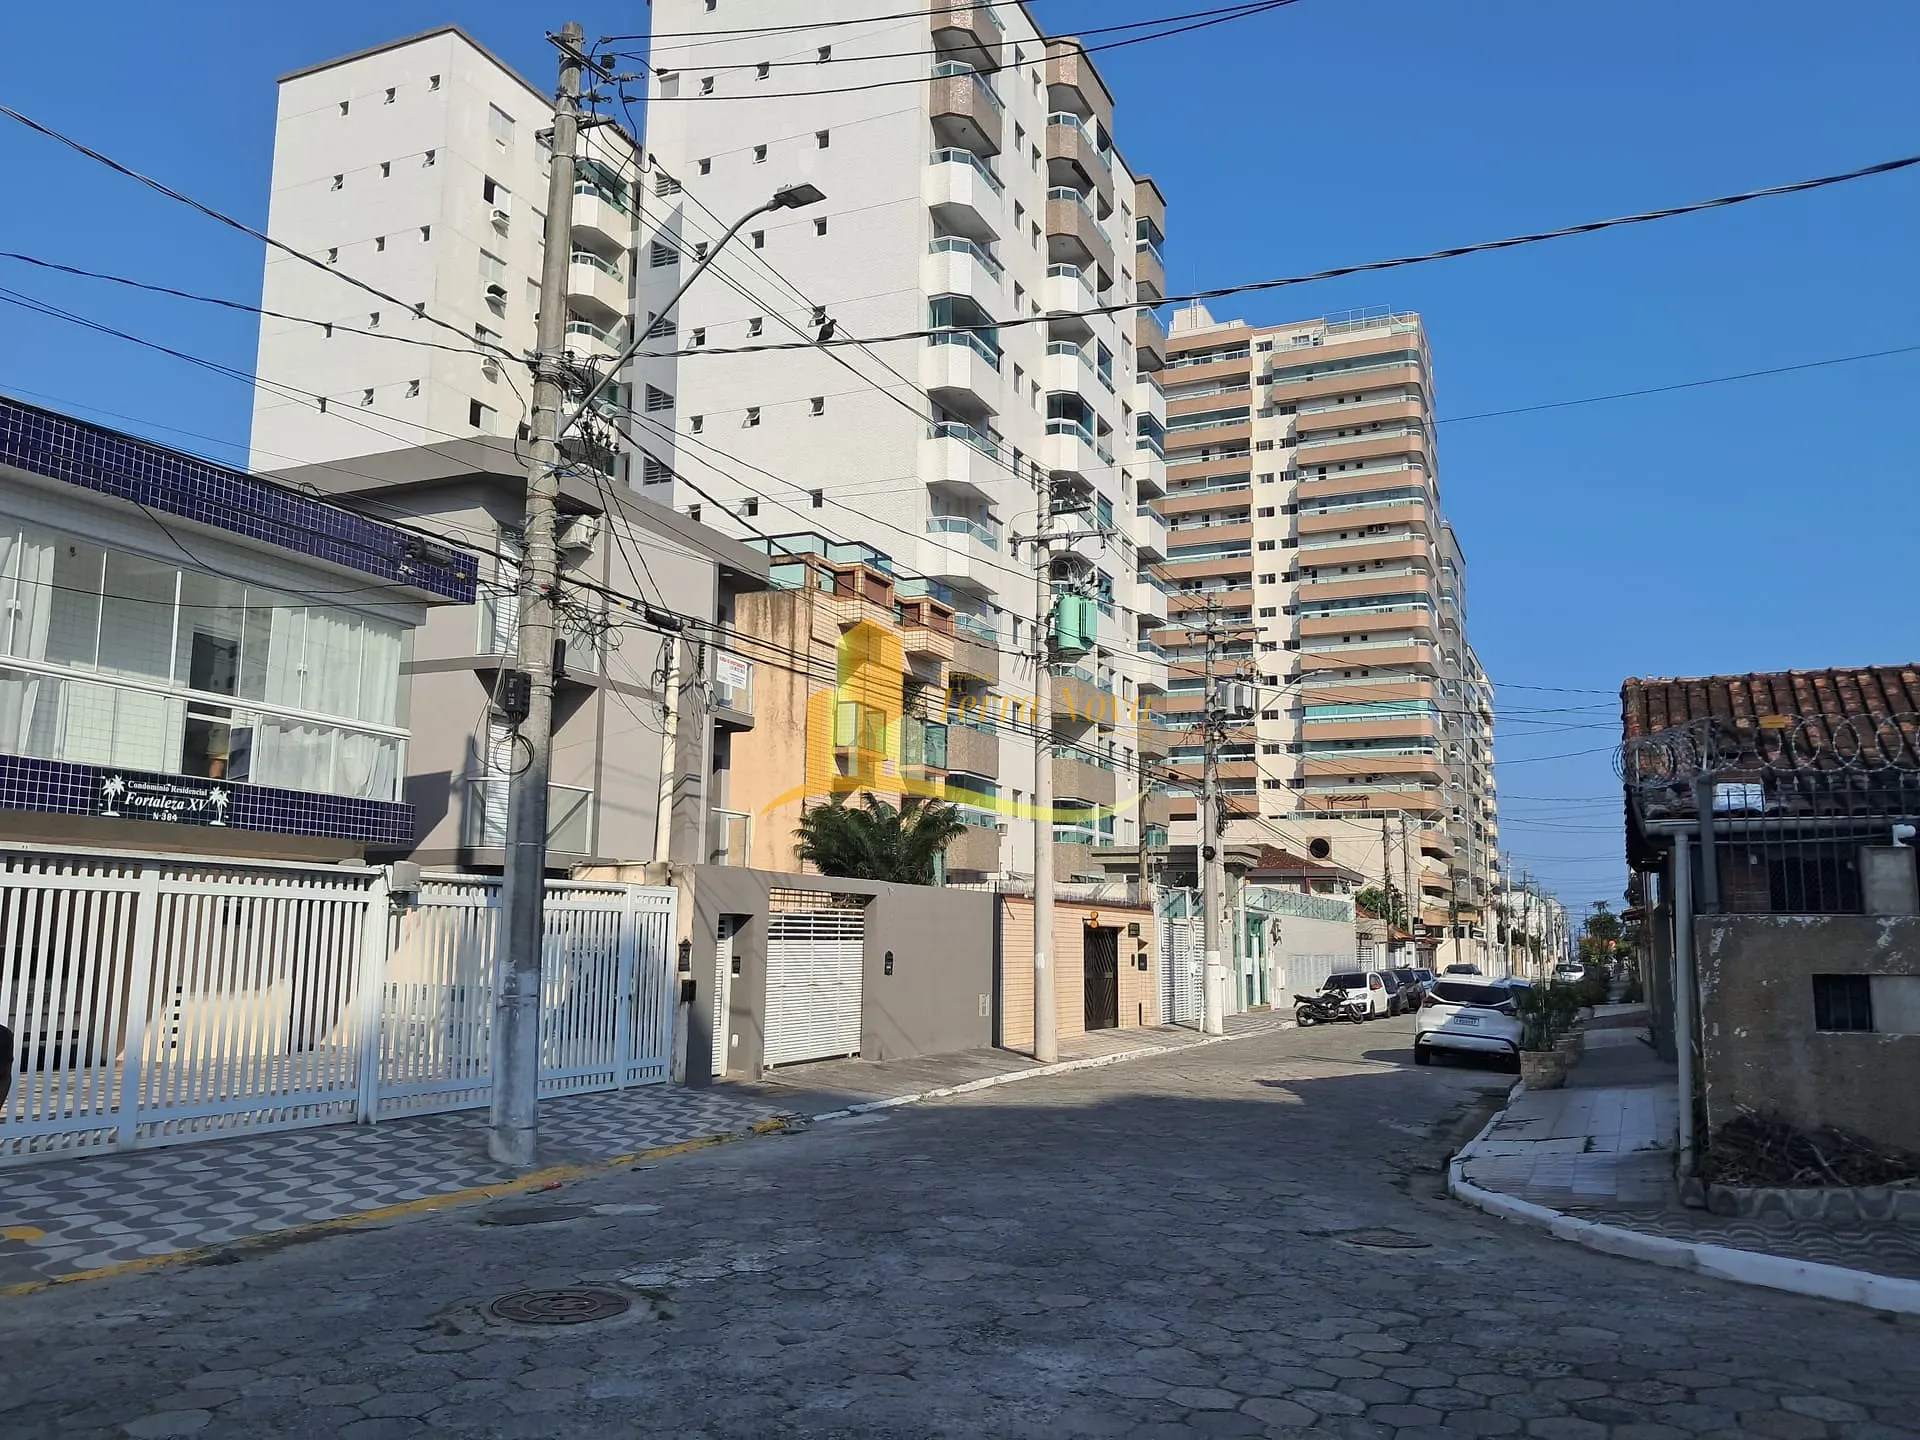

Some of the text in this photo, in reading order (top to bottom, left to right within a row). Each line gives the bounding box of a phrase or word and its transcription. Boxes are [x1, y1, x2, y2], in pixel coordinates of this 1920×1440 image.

[170, 785, 208, 796] Residencial
[124, 791, 210, 811] Fortaleza XV
